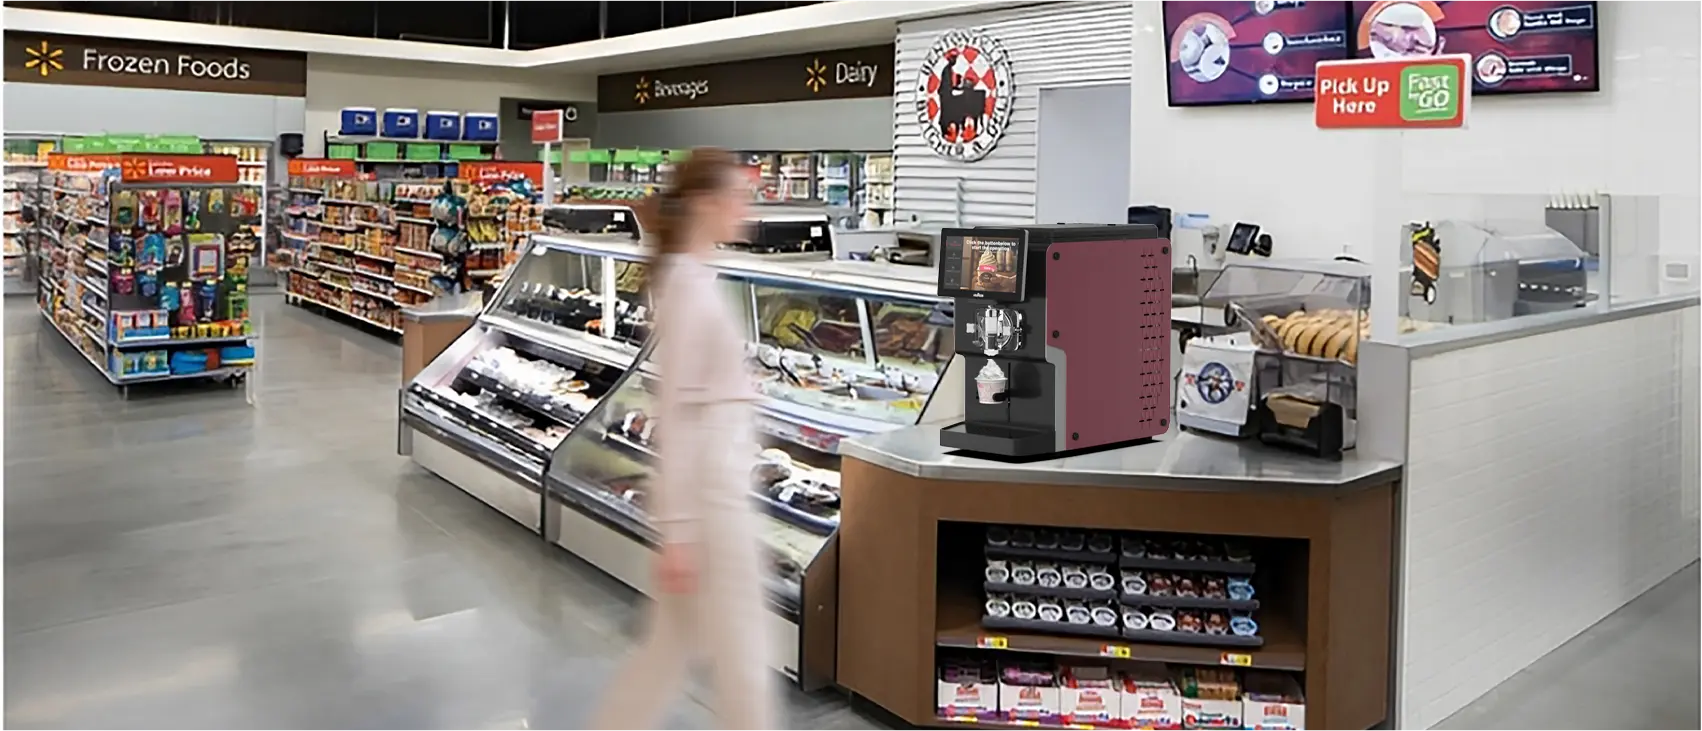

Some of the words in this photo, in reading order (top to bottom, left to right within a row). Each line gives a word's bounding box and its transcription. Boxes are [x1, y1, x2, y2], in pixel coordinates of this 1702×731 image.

[82, 48, 170, 75] Frozen
[177, 55, 251, 80] Foods
[834, 60, 878, 91] Dairy
[1319, 77, 1358, 95] Pick
[1363, 76, 1390, 97] Up
[1332, 97, 1377, 114] Here
[1418, 89, 1450, 108] GO
